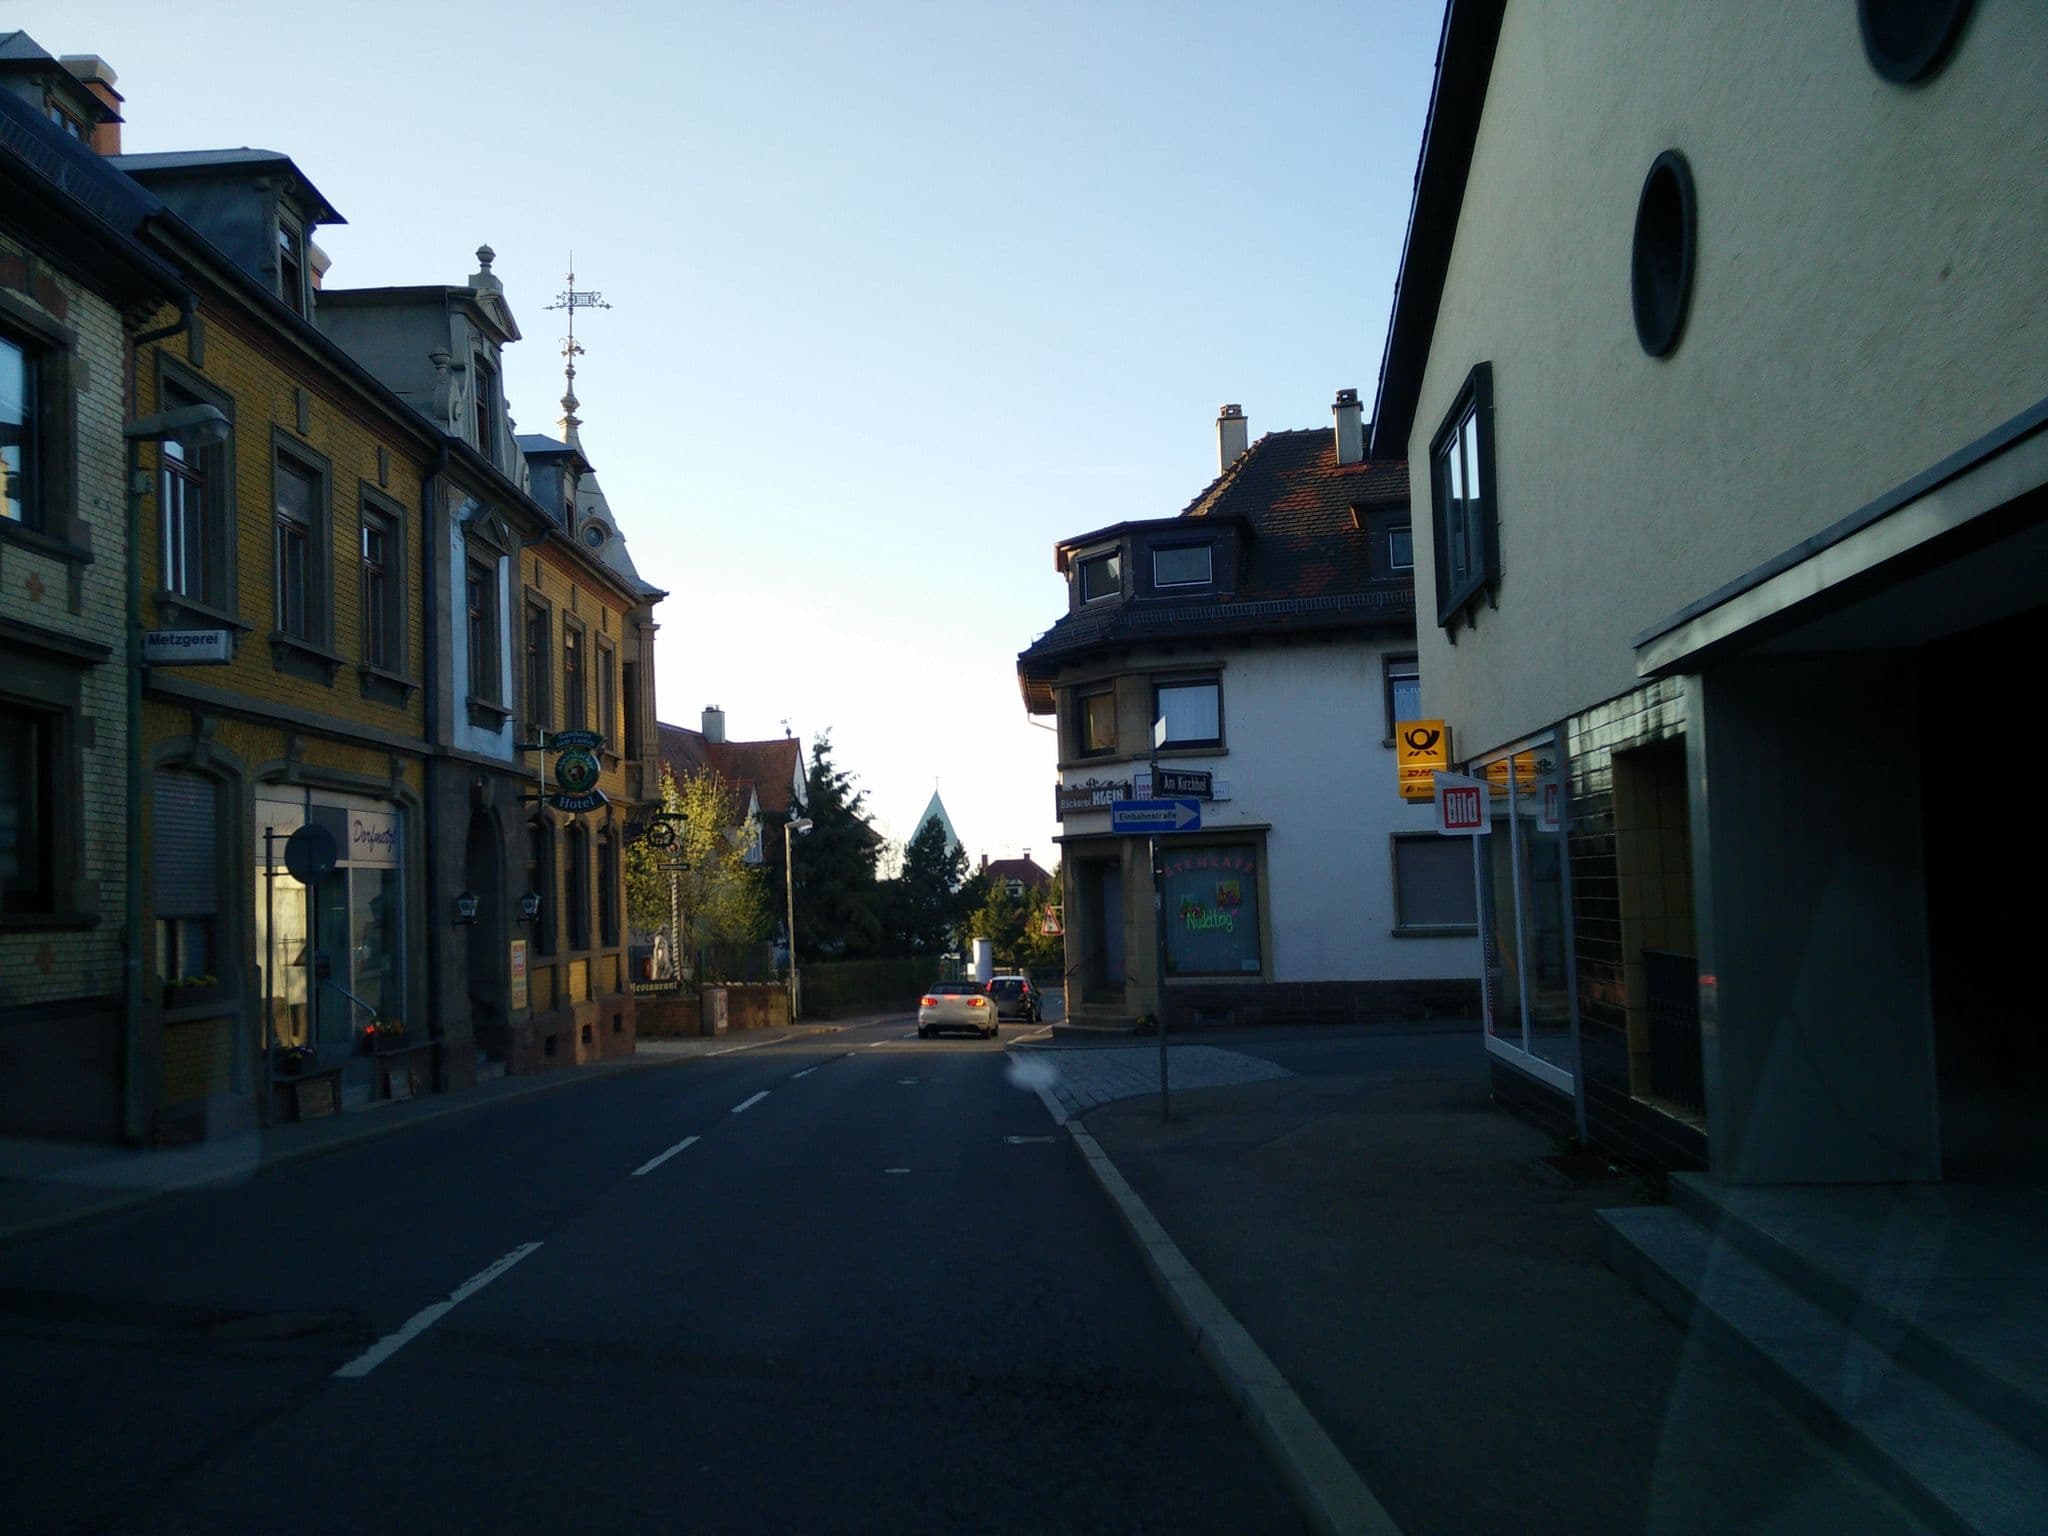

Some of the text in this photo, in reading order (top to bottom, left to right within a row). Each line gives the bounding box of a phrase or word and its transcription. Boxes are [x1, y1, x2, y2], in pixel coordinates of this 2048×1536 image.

[149, 633, 218, 647] Metzgerei
[1163, 775, 1207, 794] Am Kirchhof
[559, 795, 594, 809] Hotel
[1092, 788, 1124, 805] KLEIN
[1447, 792, 1479, 824] Bild
[1118, 811, 1177, 822] Einbahnstraße
